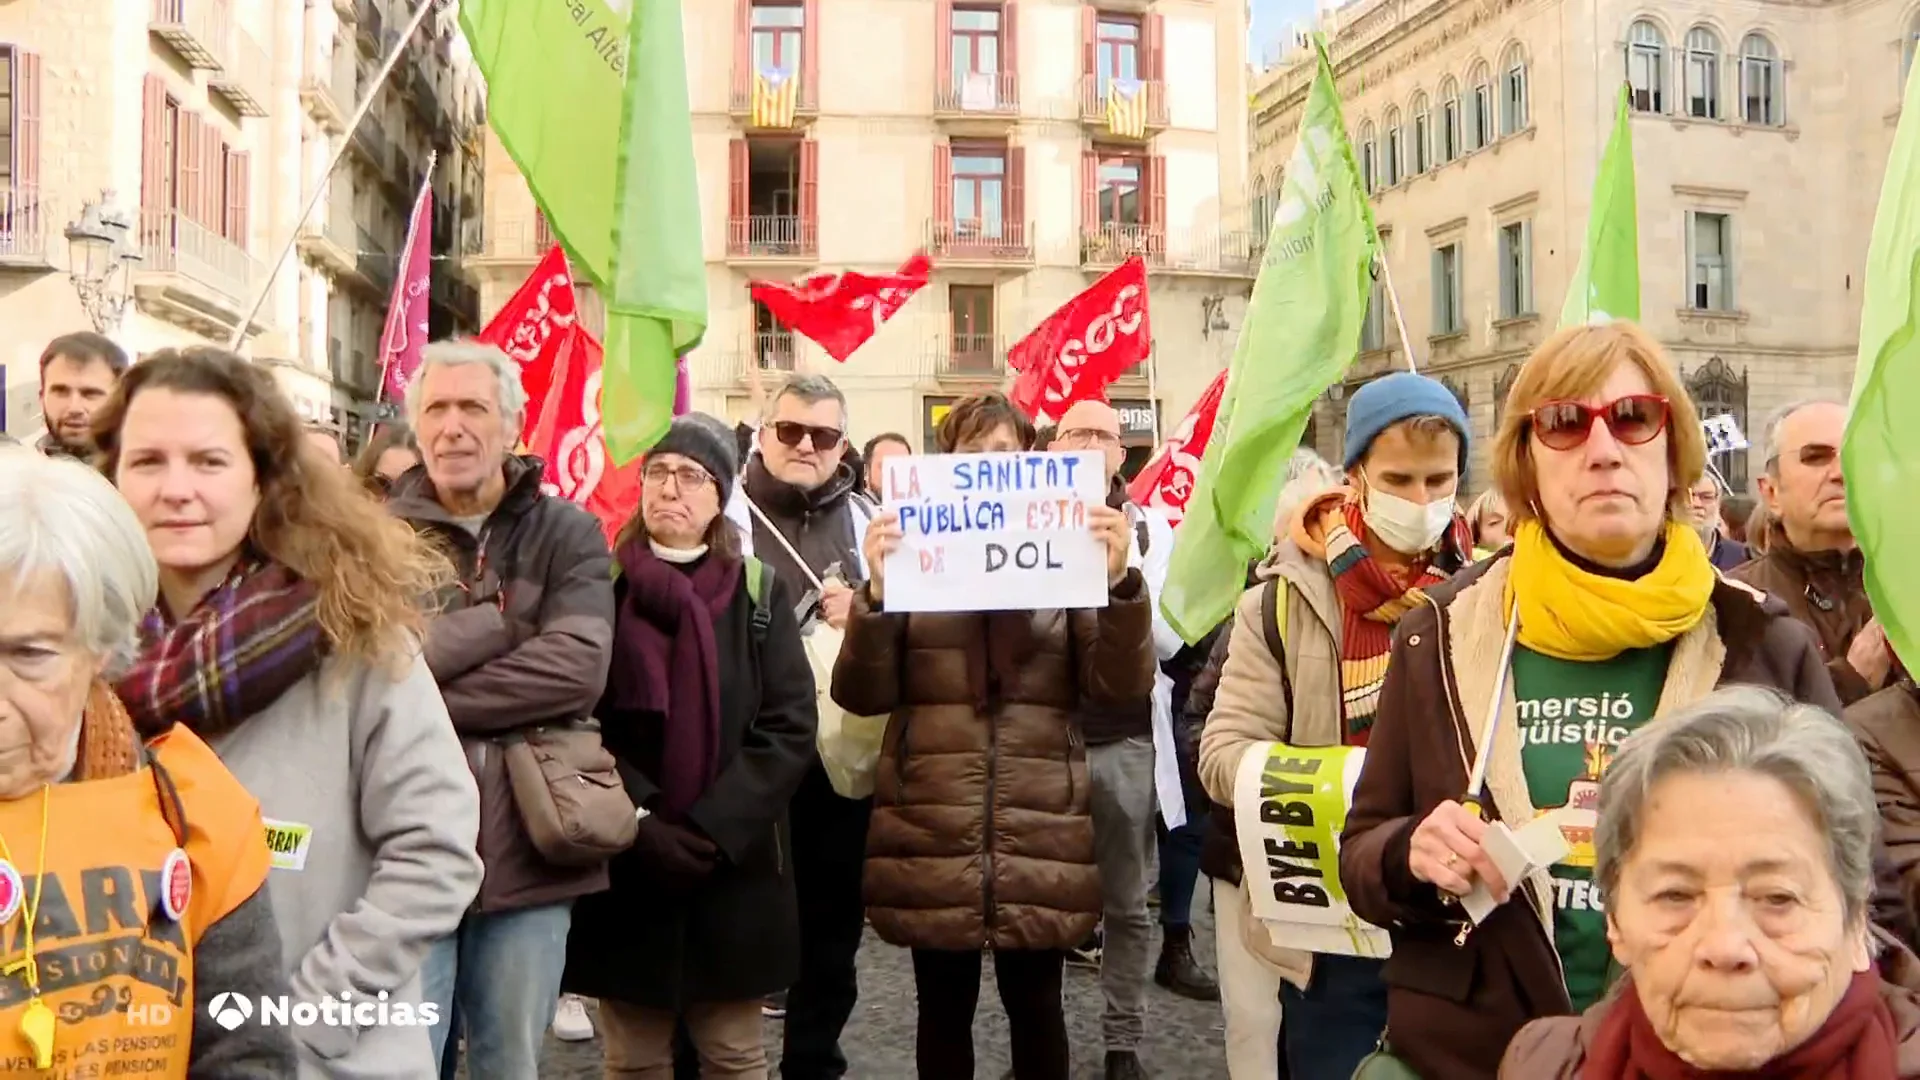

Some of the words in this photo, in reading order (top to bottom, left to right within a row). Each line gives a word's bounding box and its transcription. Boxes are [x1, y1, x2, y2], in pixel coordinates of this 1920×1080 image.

[585, 27, 625, 78] Alte
[1119, 408, 1152, 424] ans
[890, 465, 921, 500] LA
[953, 454, 1079, 492] SANITAT
[900, 496, 1004, 535] PÚBLICA
[919, 546, 944, 573] DE
[985, 540, 1062, 572] DOL
[1516, 692, 1633, 719] mersió
[1519, 719, 1629, 751] güístic
[1260, 755, 1322, 827] BYE
[266, 828, 302, 854] BRAY
[1264, 837, 1330, 908] BYE
